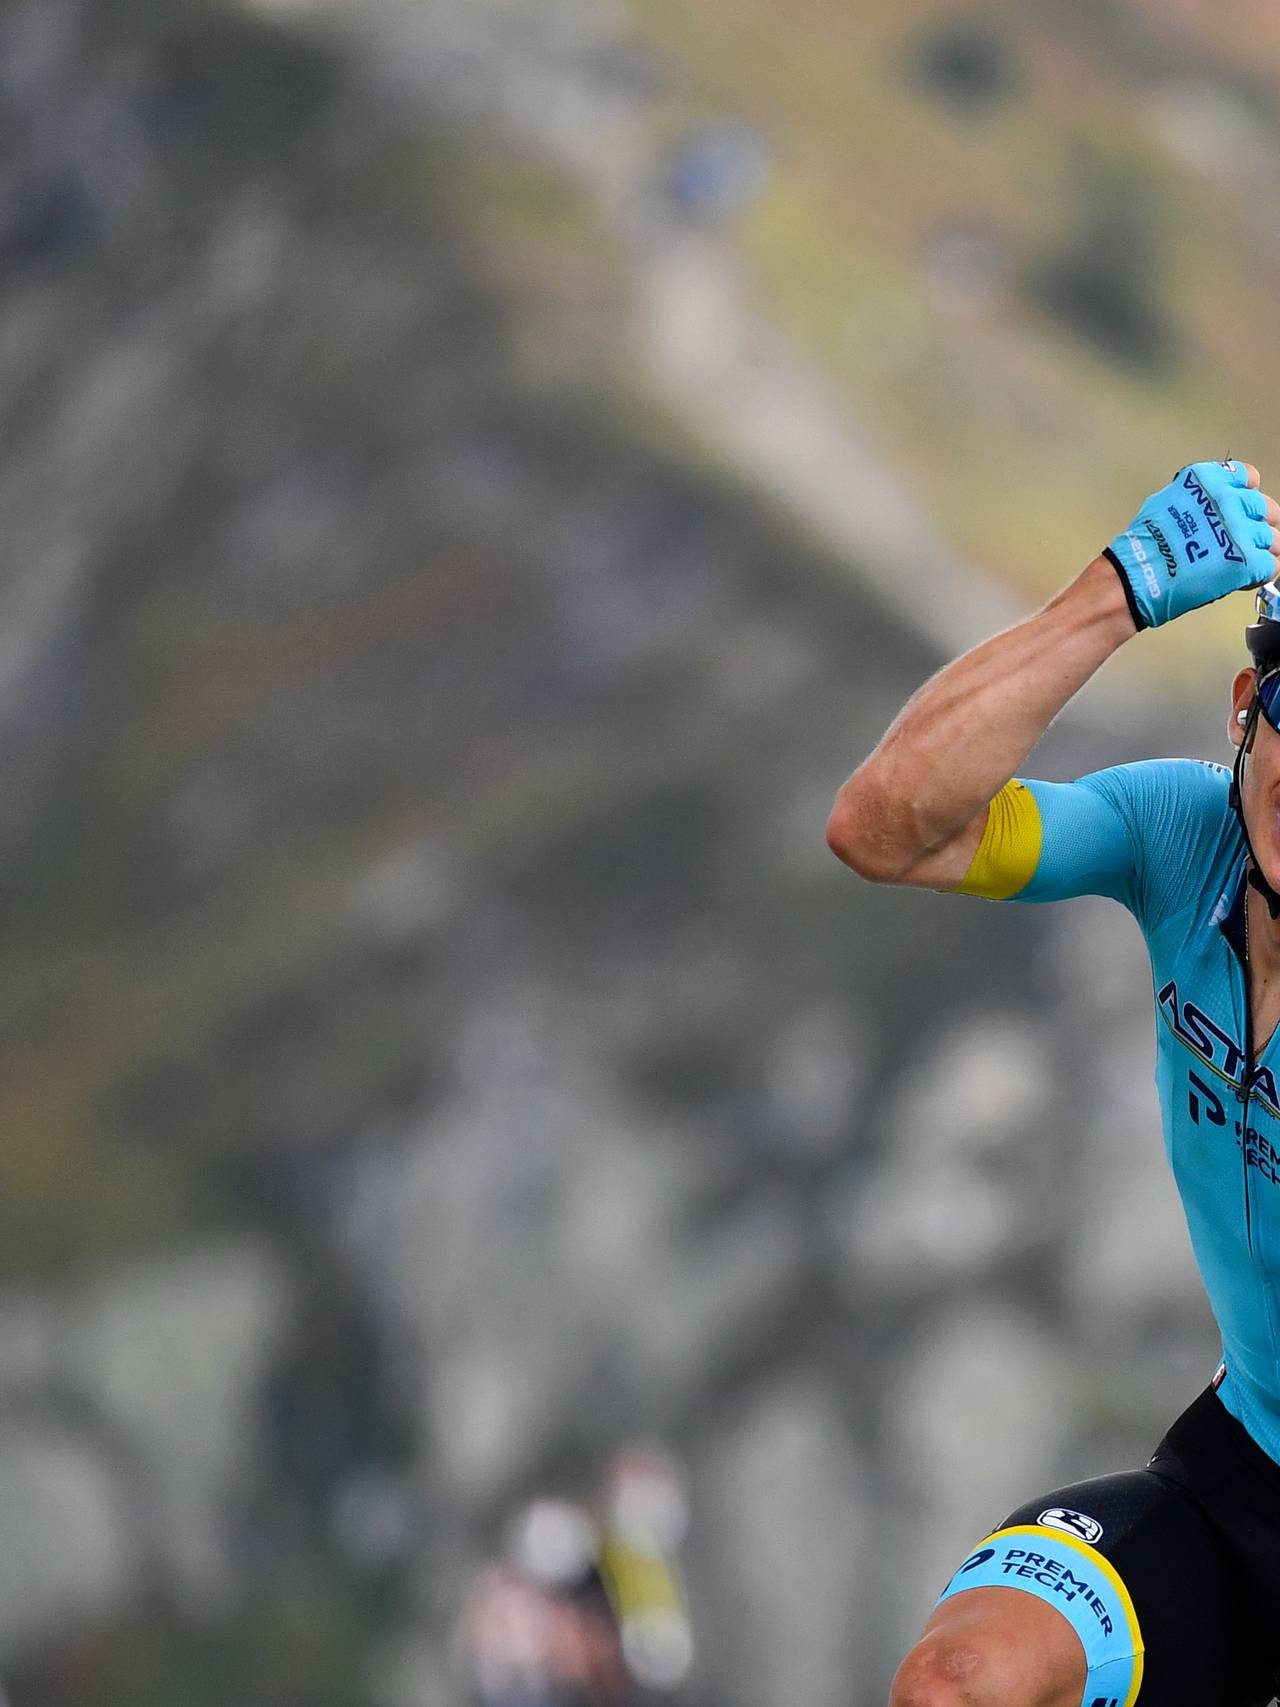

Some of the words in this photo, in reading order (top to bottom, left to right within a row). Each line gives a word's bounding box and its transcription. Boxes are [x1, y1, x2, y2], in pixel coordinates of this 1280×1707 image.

[1167, 505, 1192, 539] PREMIER
[1182, 510, 1199, 535] TECH
[1183, 471, 1244, 563] ASTANA
[1001, 1562, 1077, 1602] TECH
[1004, 1549, 1113, 1637] PREMIER
